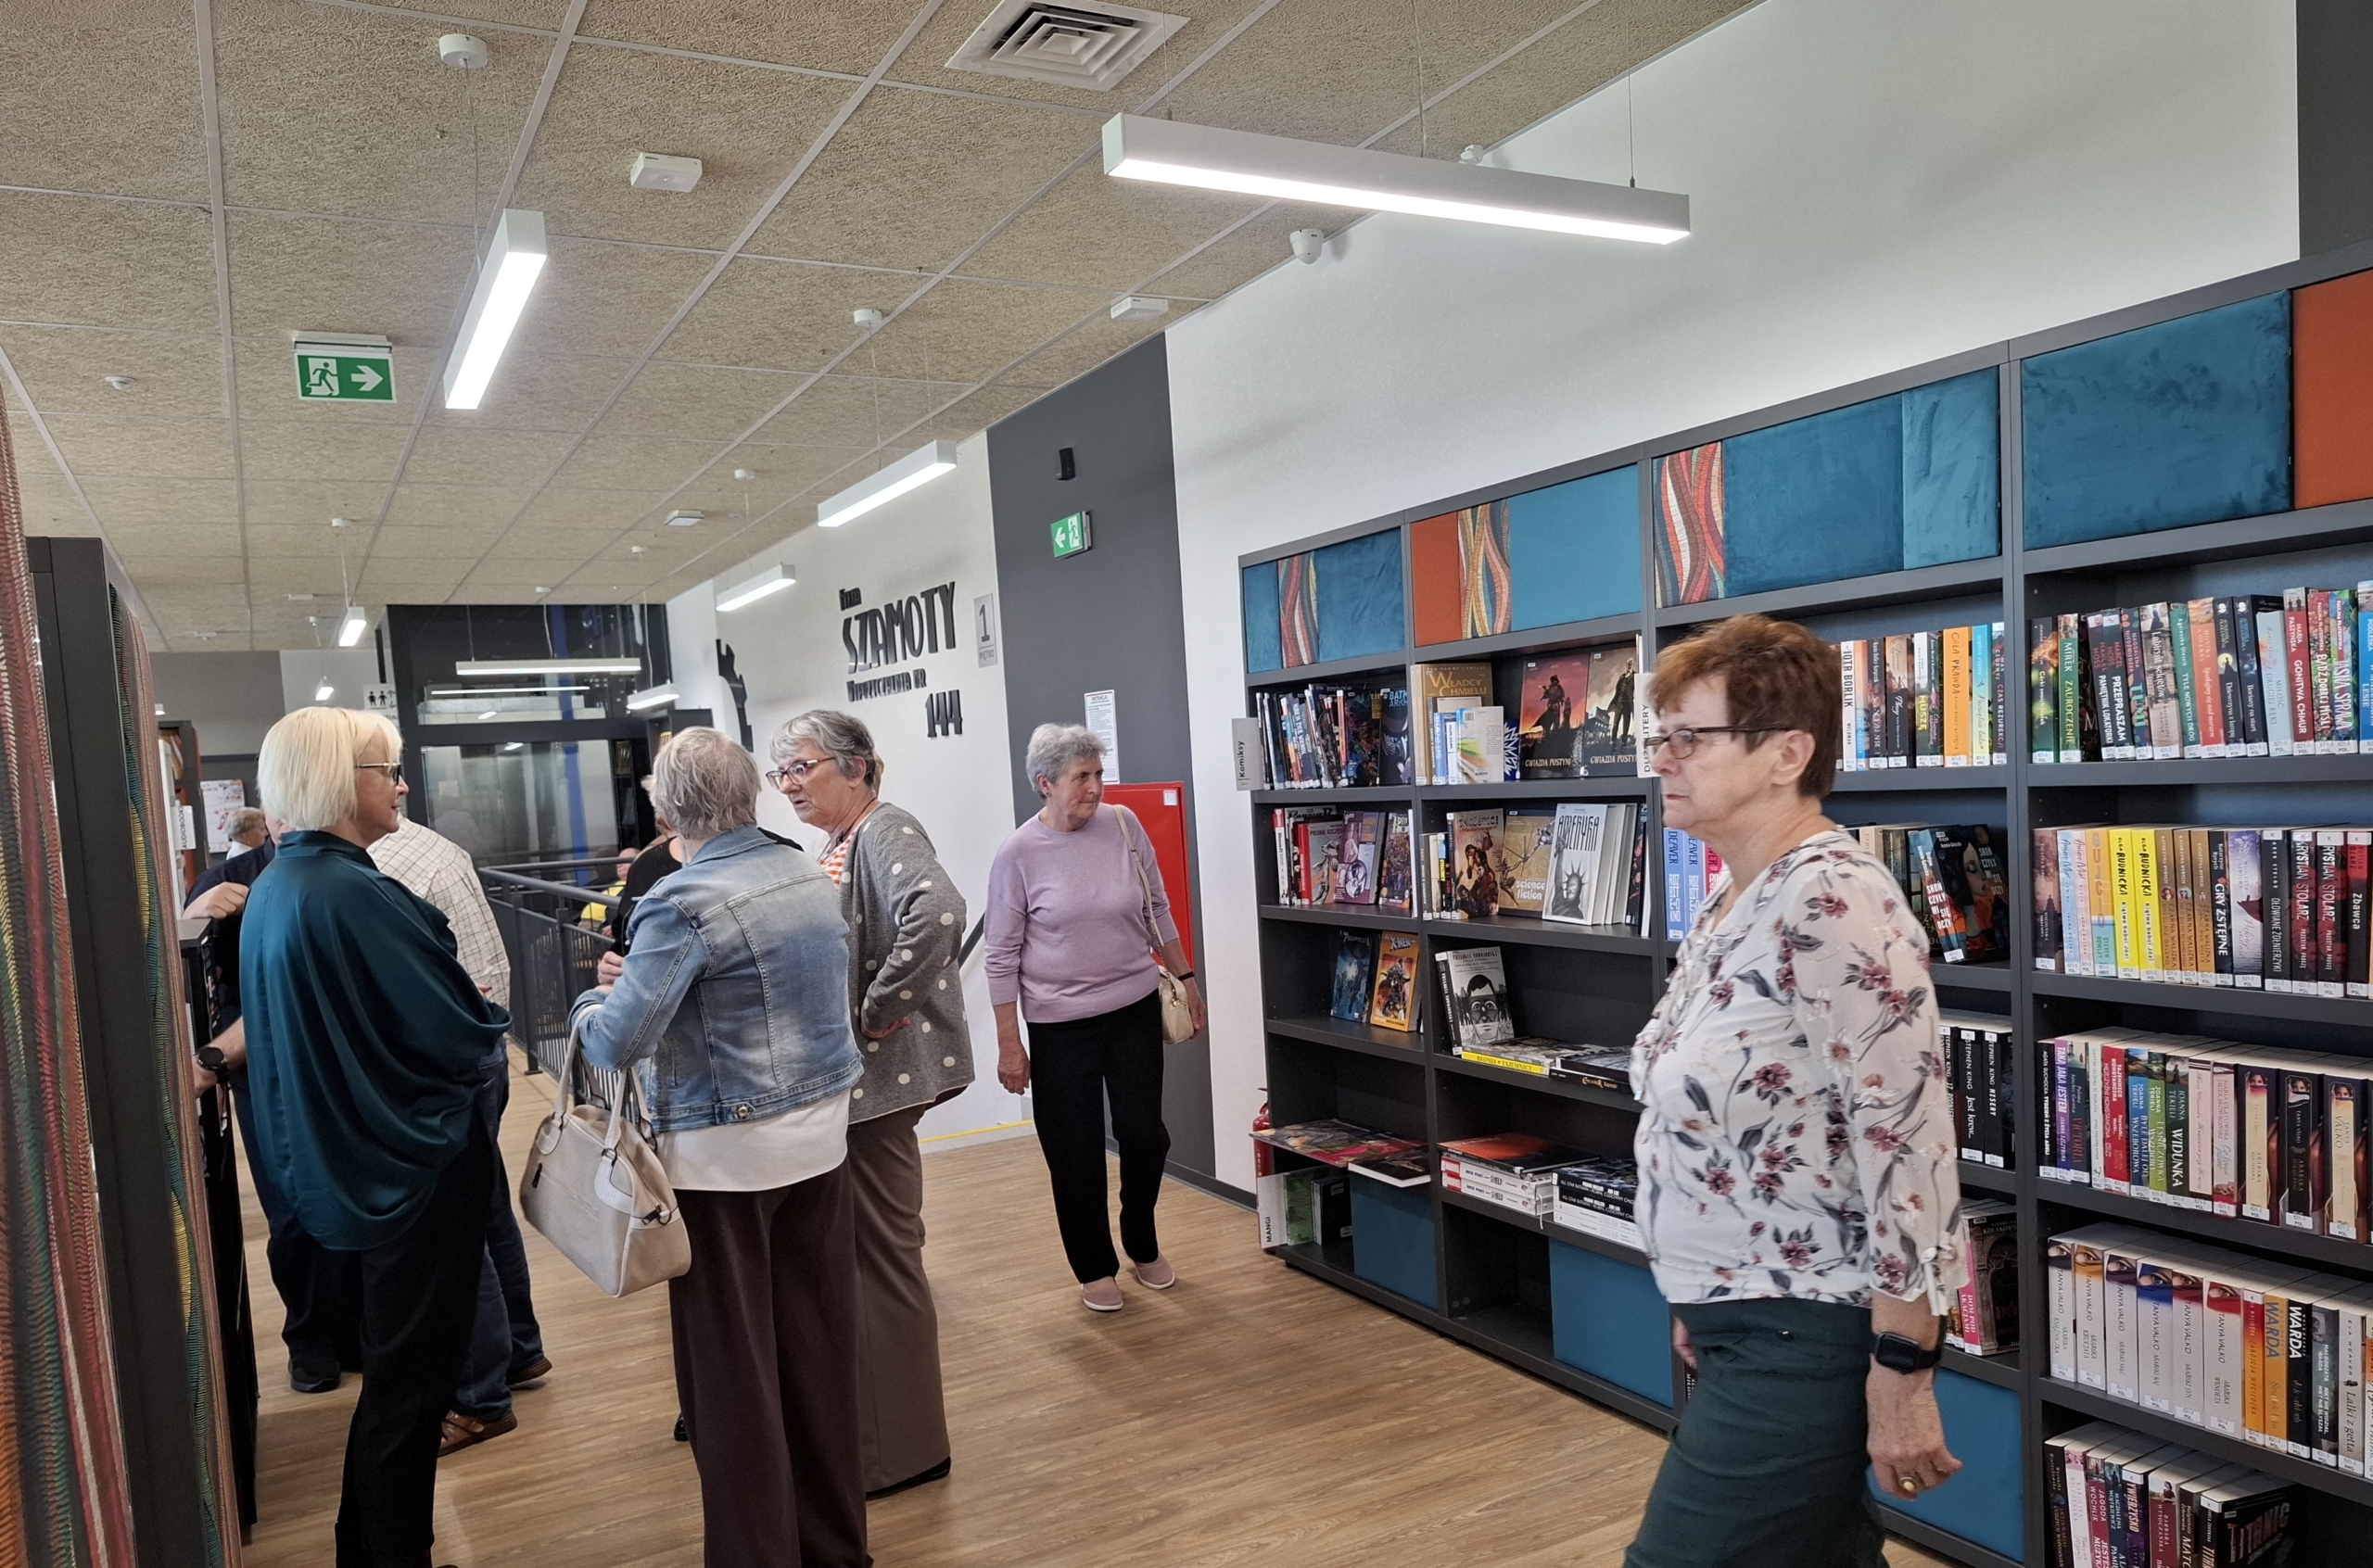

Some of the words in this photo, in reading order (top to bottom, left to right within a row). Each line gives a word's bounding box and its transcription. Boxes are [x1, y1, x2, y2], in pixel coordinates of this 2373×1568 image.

[843, 581, 956, 675] SZAMOTY
[979, 604, 990, 642] 1
[2289, 617, 2297, 652] PASZYŃSKA
[2064, 642, 2073, 672] MIREK
[2151, 631, 2164, 664] Labirynt
[1428, 671, 1481, 688] WŁADCY
[1951, 660, 1961, 694] PRAWDA
[2265, 674, 2275, 704] DRUGIEJ
[2294, 660, 2305, 702] GONITWA
[2333, 658, 2350, 689] JASNA
[1389, 690, 1407, 700] BATM
[1844, 676, 1853, 707] BORLIK
[2099, 675, 2109, 709] PAMIĘTNIK
[2184, 691, 2192, 721] NOWYCH
[2225, 682, 2234, 714] Dziewczyna
[2247, 685, 2255, 707] Bociany
[925, 689, 962, 738] 144
[1918, 695, 1927, 730] MUSZĘ
[2064, 680, 2074, 744] ZAUROCZENIE
[2113, 676, 2126, 741] PRZEPRASZAM
[2267, 707, 2277, 725] RĘKI
[2297, 703, 2307, 734] CHMUR
[2320, 705, 2331, 728] MYŚLI
[2334, 693, 2352, 729] SPRAWA
[2102, 710, 2113, 743] LOKATORKI
[2187, 723, 2196, 741] DRÓG
[1237, 740, 1246, 778] Komiksy
[1525, 759, 1548, 767] GWIAZDA
[1590, 755, 1616, 764] GWIAZDA
[1617, 754, 1637, 763] PUSTY
[1669, 831, 1679, 864] DEAVER
[1689, 835, 1698, 866] EAVER
[2296, 841, 2309, 879] KRYSTIAN
[1516, 880, 1546, 890] science
[1926, 880, 1943, 894] SKOŃ
[2116, 853, 2128, 895] RUDNICKA
[2139, 854, 2151, 897] RUDNICKA
[1516, 890, 1542, 901] fiction
[1928, 892, 1946, 905] CZYŁY
[1931, 905, 1939, 915] MI
[2214, 883, 2226, 906] GRY
[2296, 884, 2309, 920] STOLARZ
[2322, 884, 2335, 921] STOLARZ
[1936, 920, 1952, 929] OCZY
[1940, 908, 1950, 918] SIĘ
[2271, 898, 2281, 929] OŁOWIANE
[2352, 892, 2362, 929] Zbawca
[1390, 936, 1411, 951] X-MEN
[2214, 909, 2227, 955] ZSTĘPNE
[2272, 931, 2283, 972] ŻOŁNIERZYKI
[2056, 1046, 2066, 1065] TAKĄ
[2057, 1066, 2066, 1083] JAKA
[1966, 1095, 1975, 1112] Jest
[2057, 1085, 2067, 1113] JESTEM
[2177, 1091, 2186, 1120] JOANNA
[2131, 1117, 2139, 1173] WSZEBOROWA
[2335, 1115, 2343, 1148] VALKO
[2171, 1129, 2183, 1187] WIDUNKA
[1961, 1293, 1970, 1333] AKACJAMI
[2117, 1308, 2126, 1332] VALKO
[2265, 1302, 2279, 1358] WARDA
[2289, 1306, 2302, 1359] WARDA
[2346, 1391, 2356, 1418] Lalki
[2344, 1426, 2356, 1452] getta
[2090, 1486, 2099, 1522] WOCHLIK
